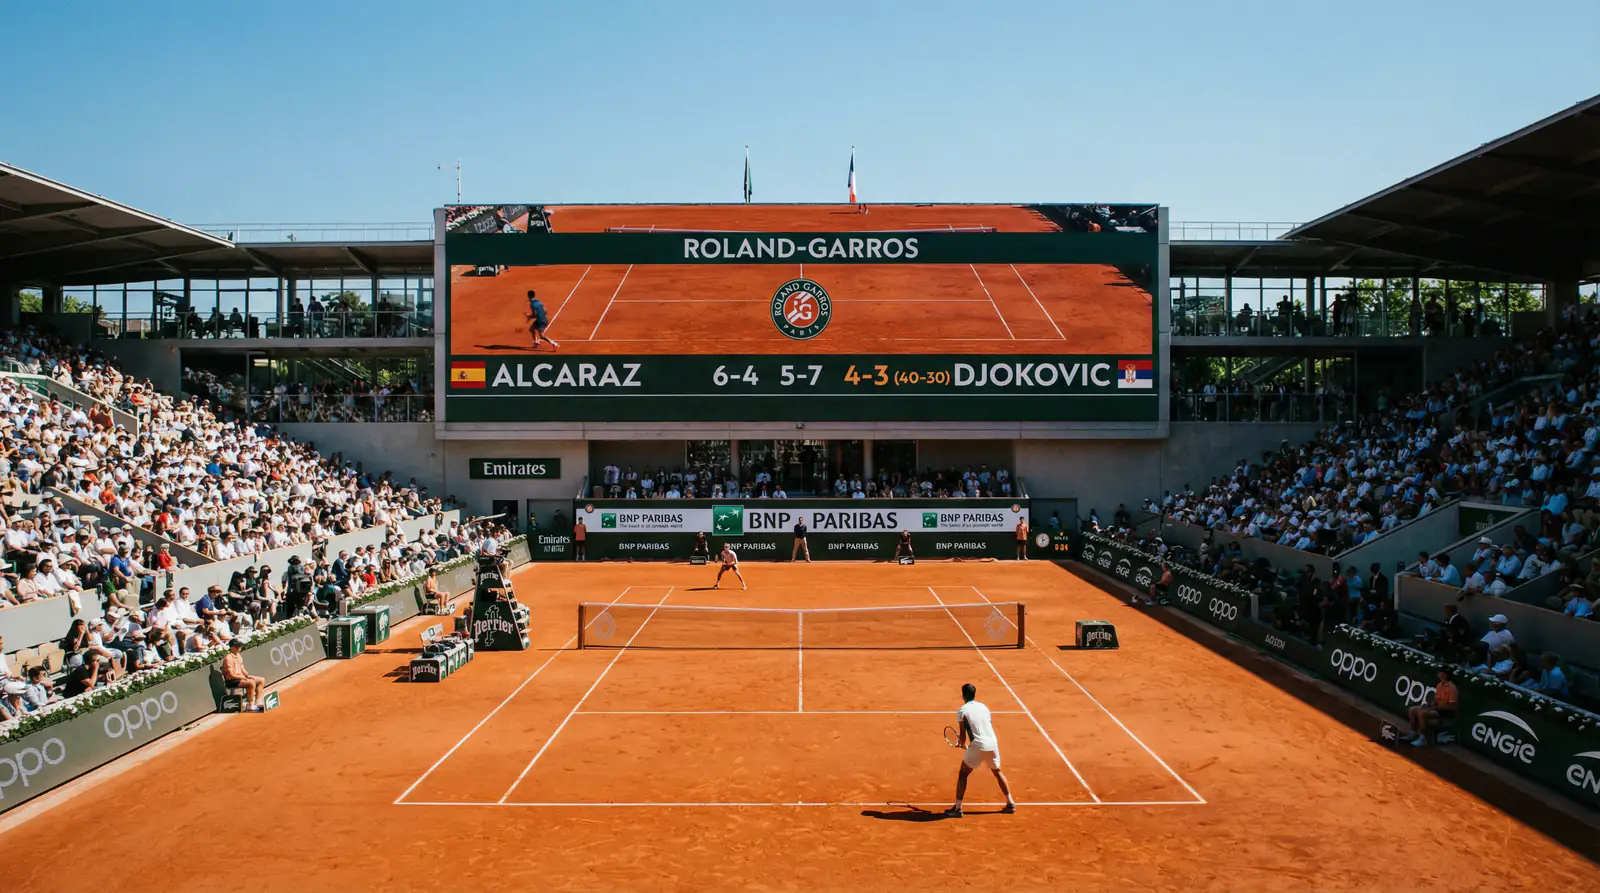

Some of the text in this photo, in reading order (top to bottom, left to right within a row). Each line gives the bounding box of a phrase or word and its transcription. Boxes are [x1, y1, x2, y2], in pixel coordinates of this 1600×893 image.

[684, 238, 919, 259] ROLAND-GARROS
[774, 283, 829, 316] ROLAND GARROS
[492, 363, 1111, 388] ALCARAZ 6-4 5-7 4-3 (40-30) DJOKOVIC
[483, 462, 546, 476] Emirates
[620, 514, 683, 523] BNP PARIBAS
[749, 512, 898, 529] BNP PARIBAS
[940, 513, 1004, 523] BNP PARIBAS
[538, 534, 571, 544] Emirates
[936, 542, 987, 550] BNP PARIBAS
[1177, 584, 1202, 604] oppo
[1209, 597, 1237, 620] oppo
[474, 616, 514, 643] perrier
[270, 633, 314, 667] oppo
[1330, 649, 1377, 683] oppo
[1395, 675, 1437, 706] opp
[103, 690, 178, 739] oppo
[0, 737, 66, 799] ppo
